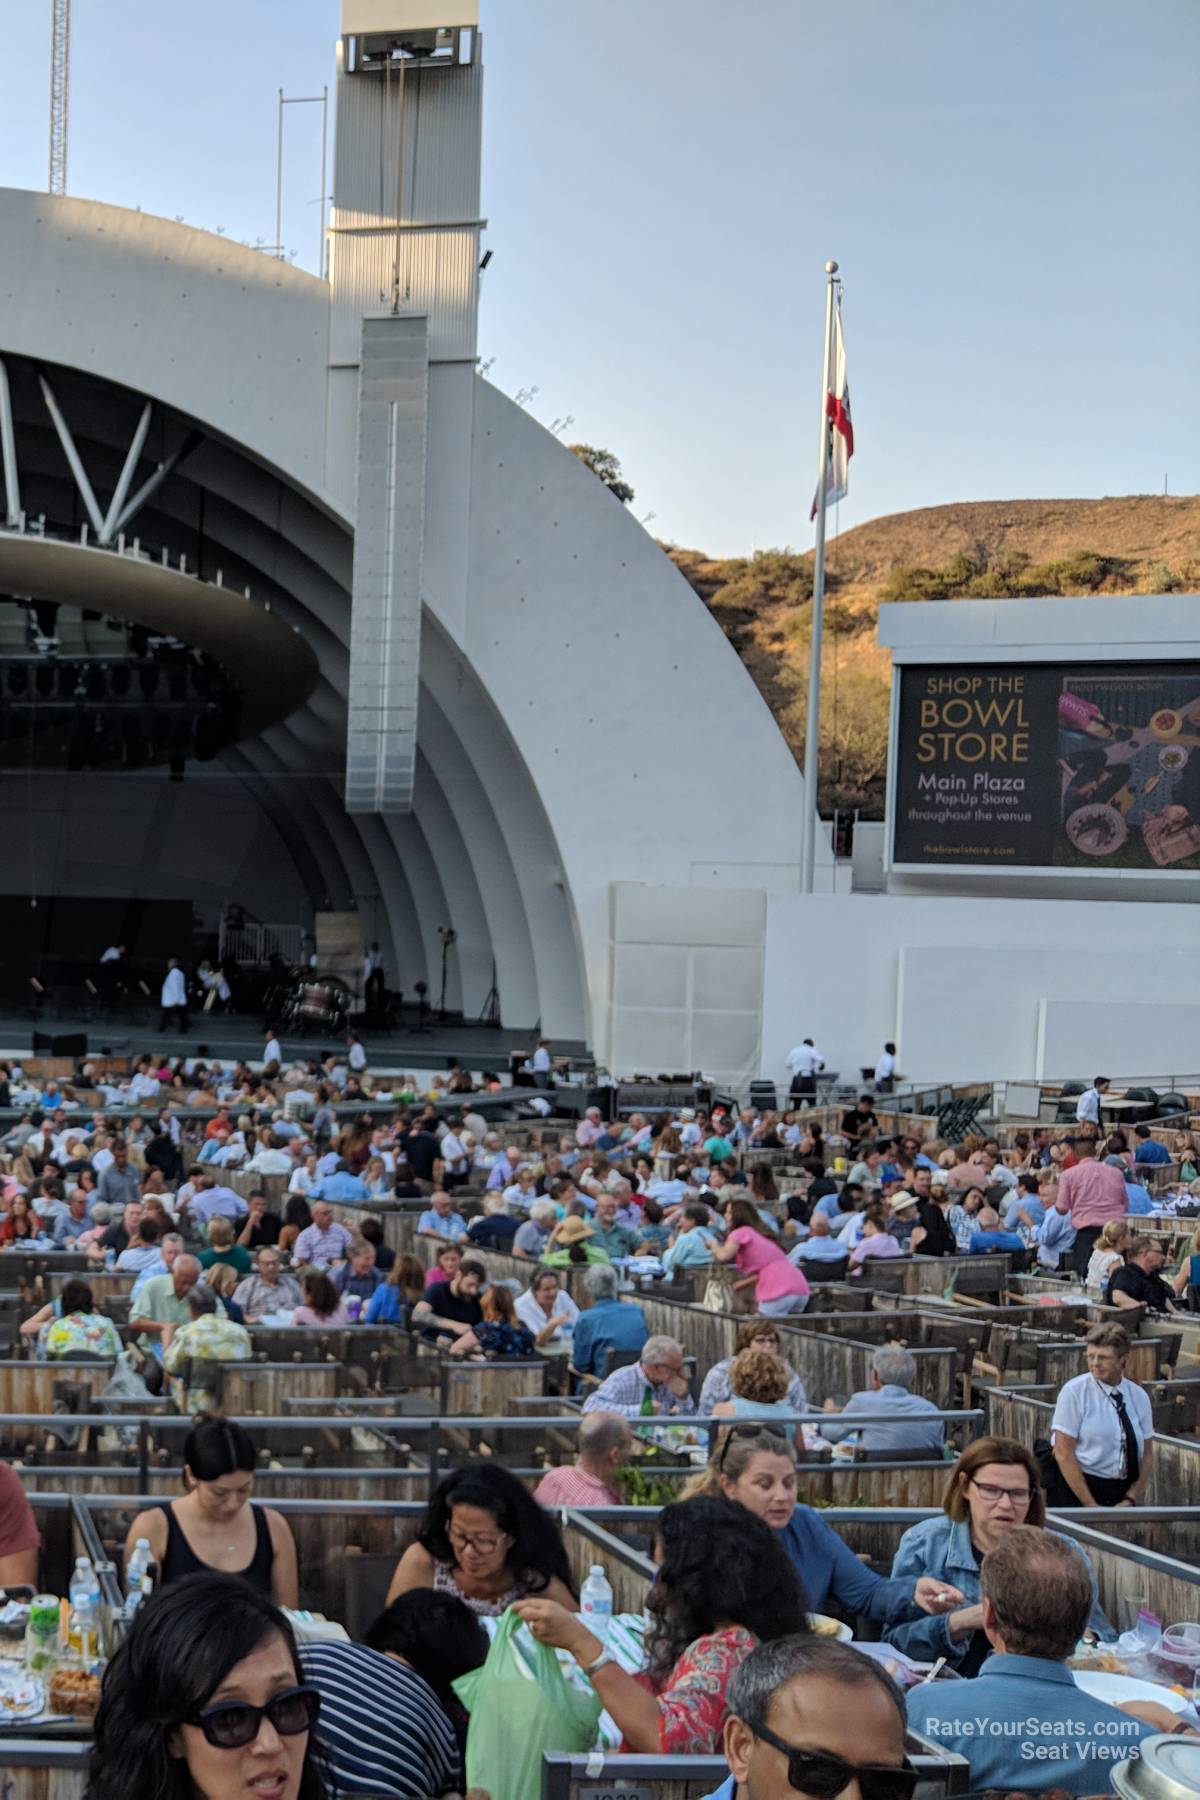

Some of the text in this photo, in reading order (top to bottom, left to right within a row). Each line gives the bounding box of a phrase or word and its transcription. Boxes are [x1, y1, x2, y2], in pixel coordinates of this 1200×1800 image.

[927, 675, 1025, 694] SHOP THE
[920, 698, 1030, 728] BOWL
[916, 732, 1029, 762] STORE
[917, 771, 1025, 791] Main Plaza
[935, 792, 978, 807] Pop-Up
[981, 792, 1019, 805] Stores
[908, 808, 1032, 824] throughout the venue
